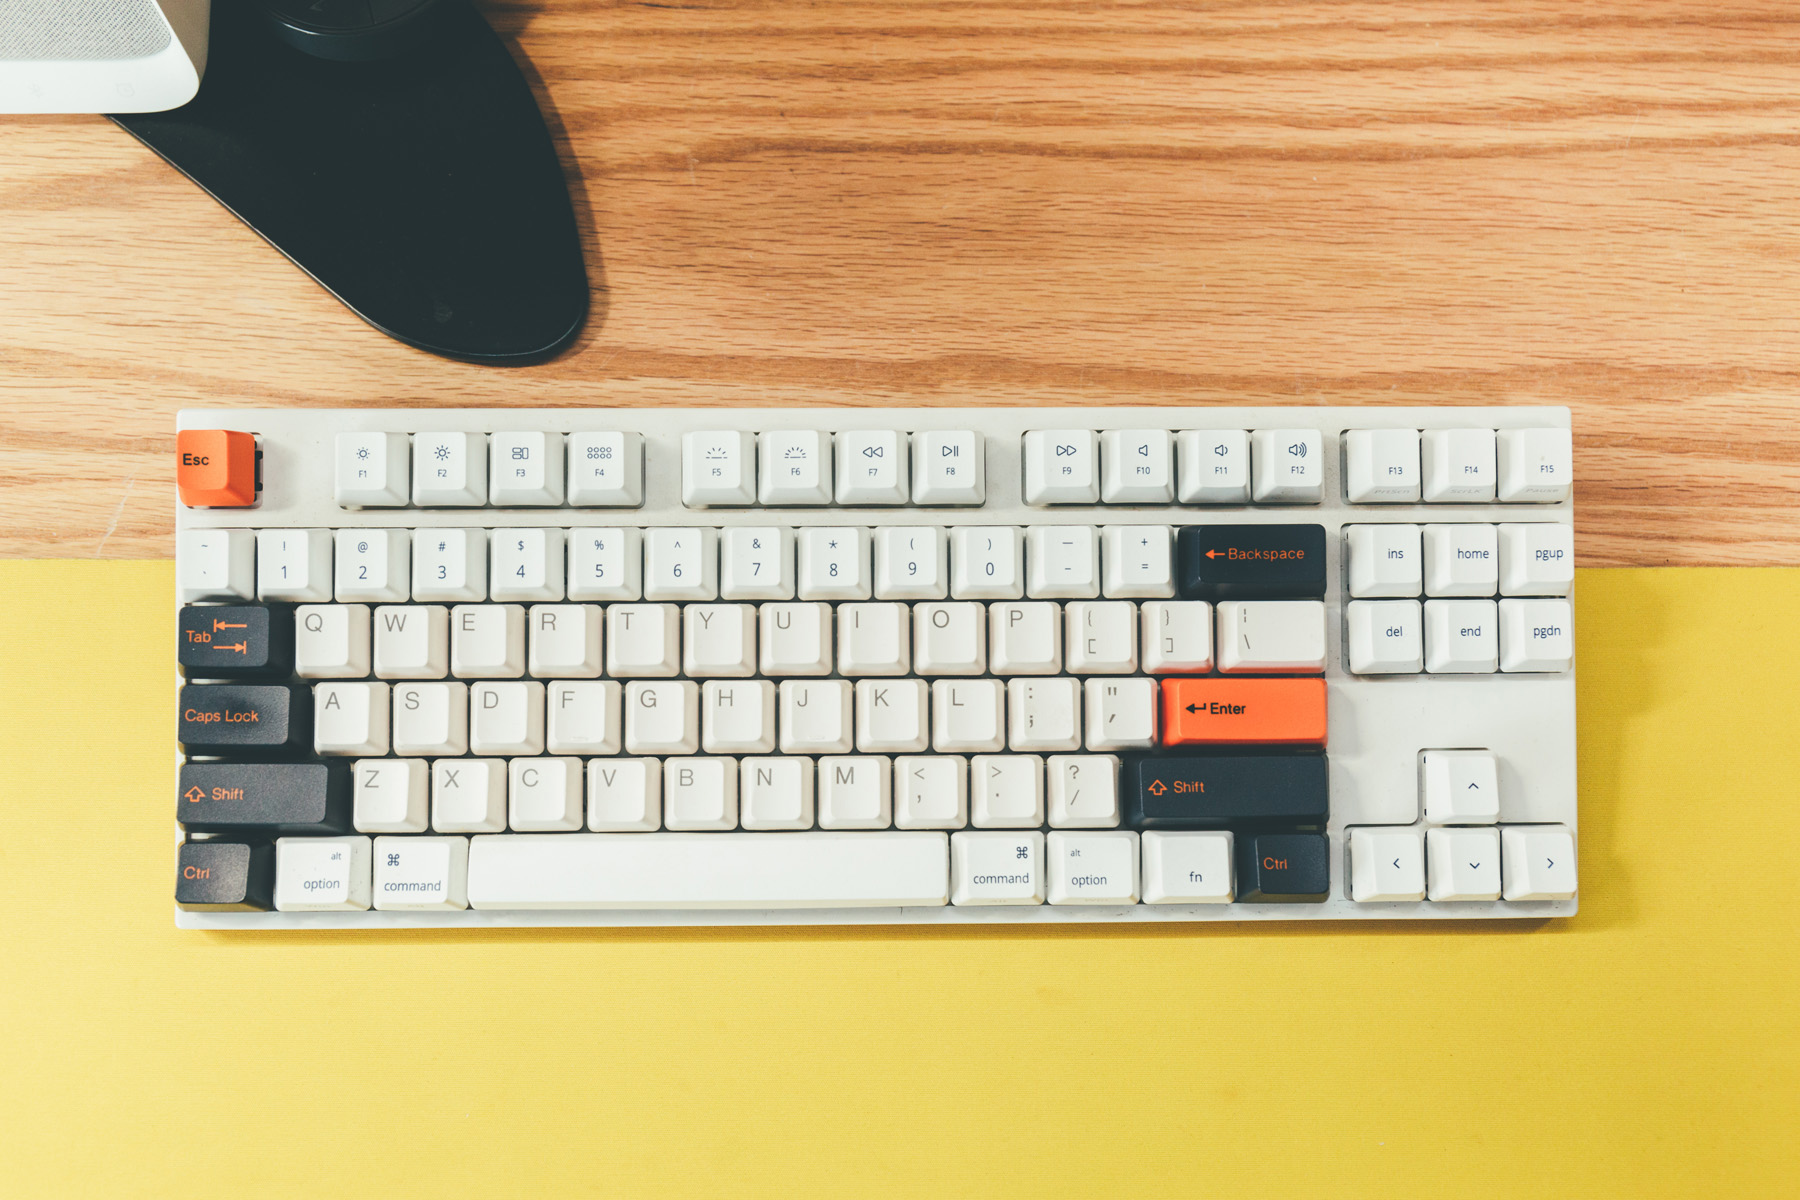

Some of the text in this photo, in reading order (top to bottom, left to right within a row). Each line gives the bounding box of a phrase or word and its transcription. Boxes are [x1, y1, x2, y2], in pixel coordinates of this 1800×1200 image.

[182, 452, 209, 466] Esc
[358, 469, 367, 478] F1
[437, 468, 447, 478] F2
[516, 468, 526, 478] F3
[594, 468, 605, 477] F4
[712, 467, 722, 477] F5
[790, 467, 801, 476] F6
[868, 468, 878, 477] F7
[946, 467, 956, 476] F8
[1062, 466, 1072, 475] F9
[1136, 466, 1151, 475] F10
[1214, 466, 1228, 474] F11
[1291, 465, 1305, 475] F12
[1388, 466, 1403, 475] F13
[1464, 465, 1479, 474] F14
[1540, 464, 1555, 474] F15
[1228, 547, 1305, 562] Backspace
[1387, 547, 1404, 559] ins
[1457, 548, 1490, 559] home
[1535, 548, 1564, 562] pgup
[281, 565, 287, 580] 1
[358, 565, 368, 580] 2
[437, 565, 447, 580] 3
[516, 564, 526, 578] 4
[595, 563, 604, 578] 5
[673, 563, 682, 578] 6
[752, 562, 761, 576] 7
[829, 562, 838, 577] 8
[908, 561, 917, 576] 9
[985, 561, 995, 576] 0
[304, 613, 323, 633] Q
[384, 613, 407, 633] W
[462, 613, 476, 632] E
[541, 612, 557, 631] R
[620, 612, 635, 631] T
[699, 611, 714, 630] Y
[776, 611, 791, 630] U
[932, 609, 950, 629] O
[1010, 609, 1024, 628] P
[185, 629, 212, 643] Tab
[1385, 626, 1403, 638] del
[1460, 625, 1481, 637] end
[1533, 625, 1561, 639] pgdn
[324, 691, 341, 710] A
[404, 691, 420, 711] S
[483, 690, 499, 709] D
[561, 690, 575, 709] F
[640, 689, 657, 709] G
[718, 688, 733, 707] H
[796, 689, 808, 708] J
[874, 688, 889, 707] K
[952, 688, 965, 707] L
[1210, 702, 1247, 715] Enter
[184, 708, 259, 725] Caps Lock
[364, 769, 380, 789] Z
[443, 769, 460, 789] X
[521, 768, 539, 788] C
[601, 768, 617, 788] V
[679, 768, 694, 787] B
[757, 767, 772, 787] N
[836, 766, 855, 785] M
[1068, 764, 1080, 780] ?
[211, 787, 244, 801] Shift
[1173, 780, 1205, 794] Shift
[330, 851, 342, 861] alt
[1070, 848, 1081, 857] alt
[1263, 856, 1288, 870] Ctrl
[183, 865, 210, 880] Ctrl
[973, 872, 1030, 885] command
[1071, 873, 1108, 887] option
[1189, 870, 1203, 883] fn
[303, 877, 341, 891] option
[383, 880, 442, 892] command
